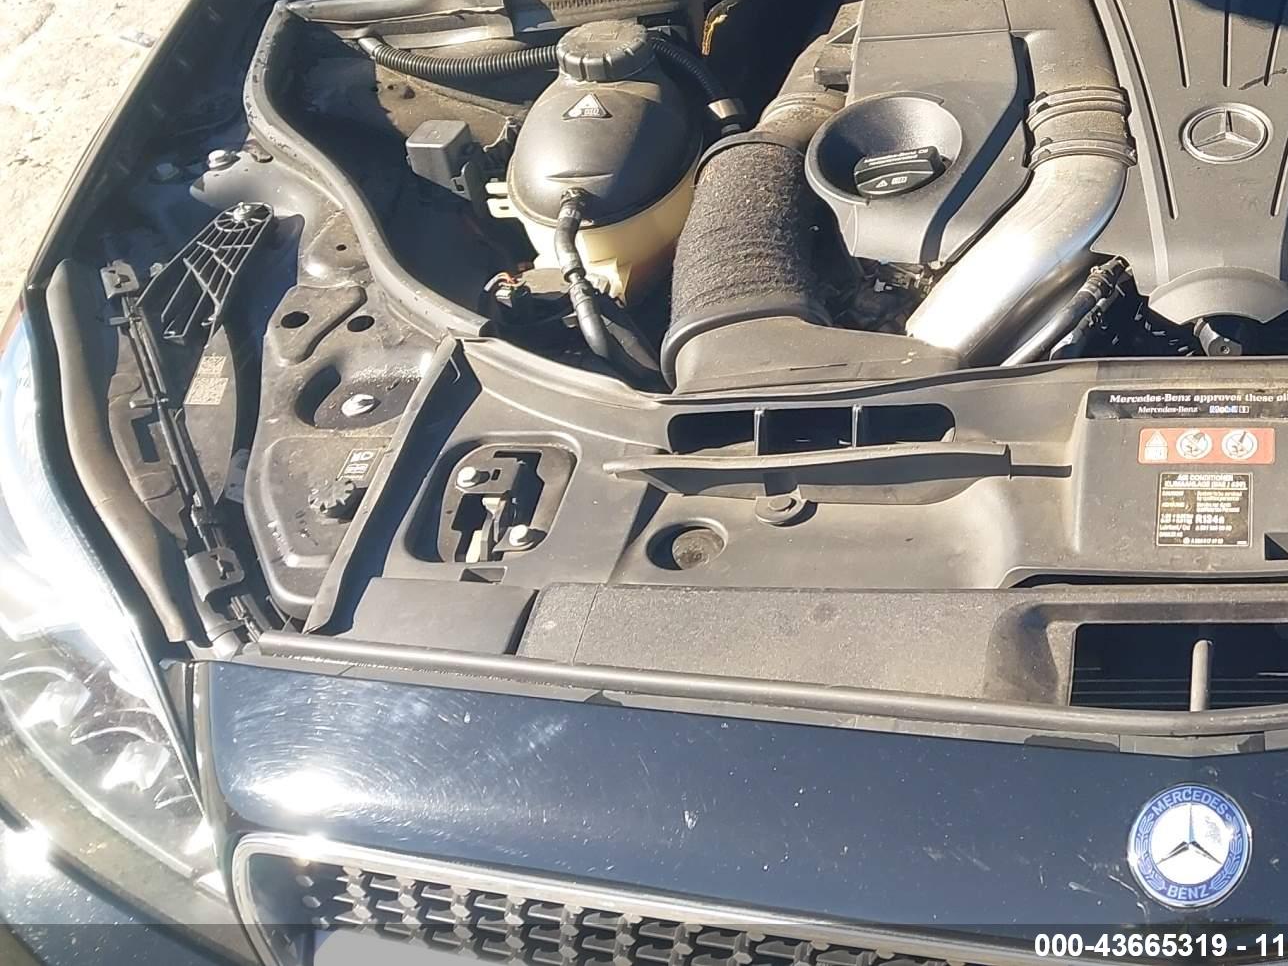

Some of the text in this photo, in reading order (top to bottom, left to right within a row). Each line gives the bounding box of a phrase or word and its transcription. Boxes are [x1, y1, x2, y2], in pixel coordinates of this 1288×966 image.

[1109, 394, 1191, 403] Mercedes-Benz
[1193, 395, 1242, 404] approves
[1244, 393, 1274, 402] these
[1151, 788, 1229, 816] MERCEDES
[1166, 884, 1211, 901] BENZ
